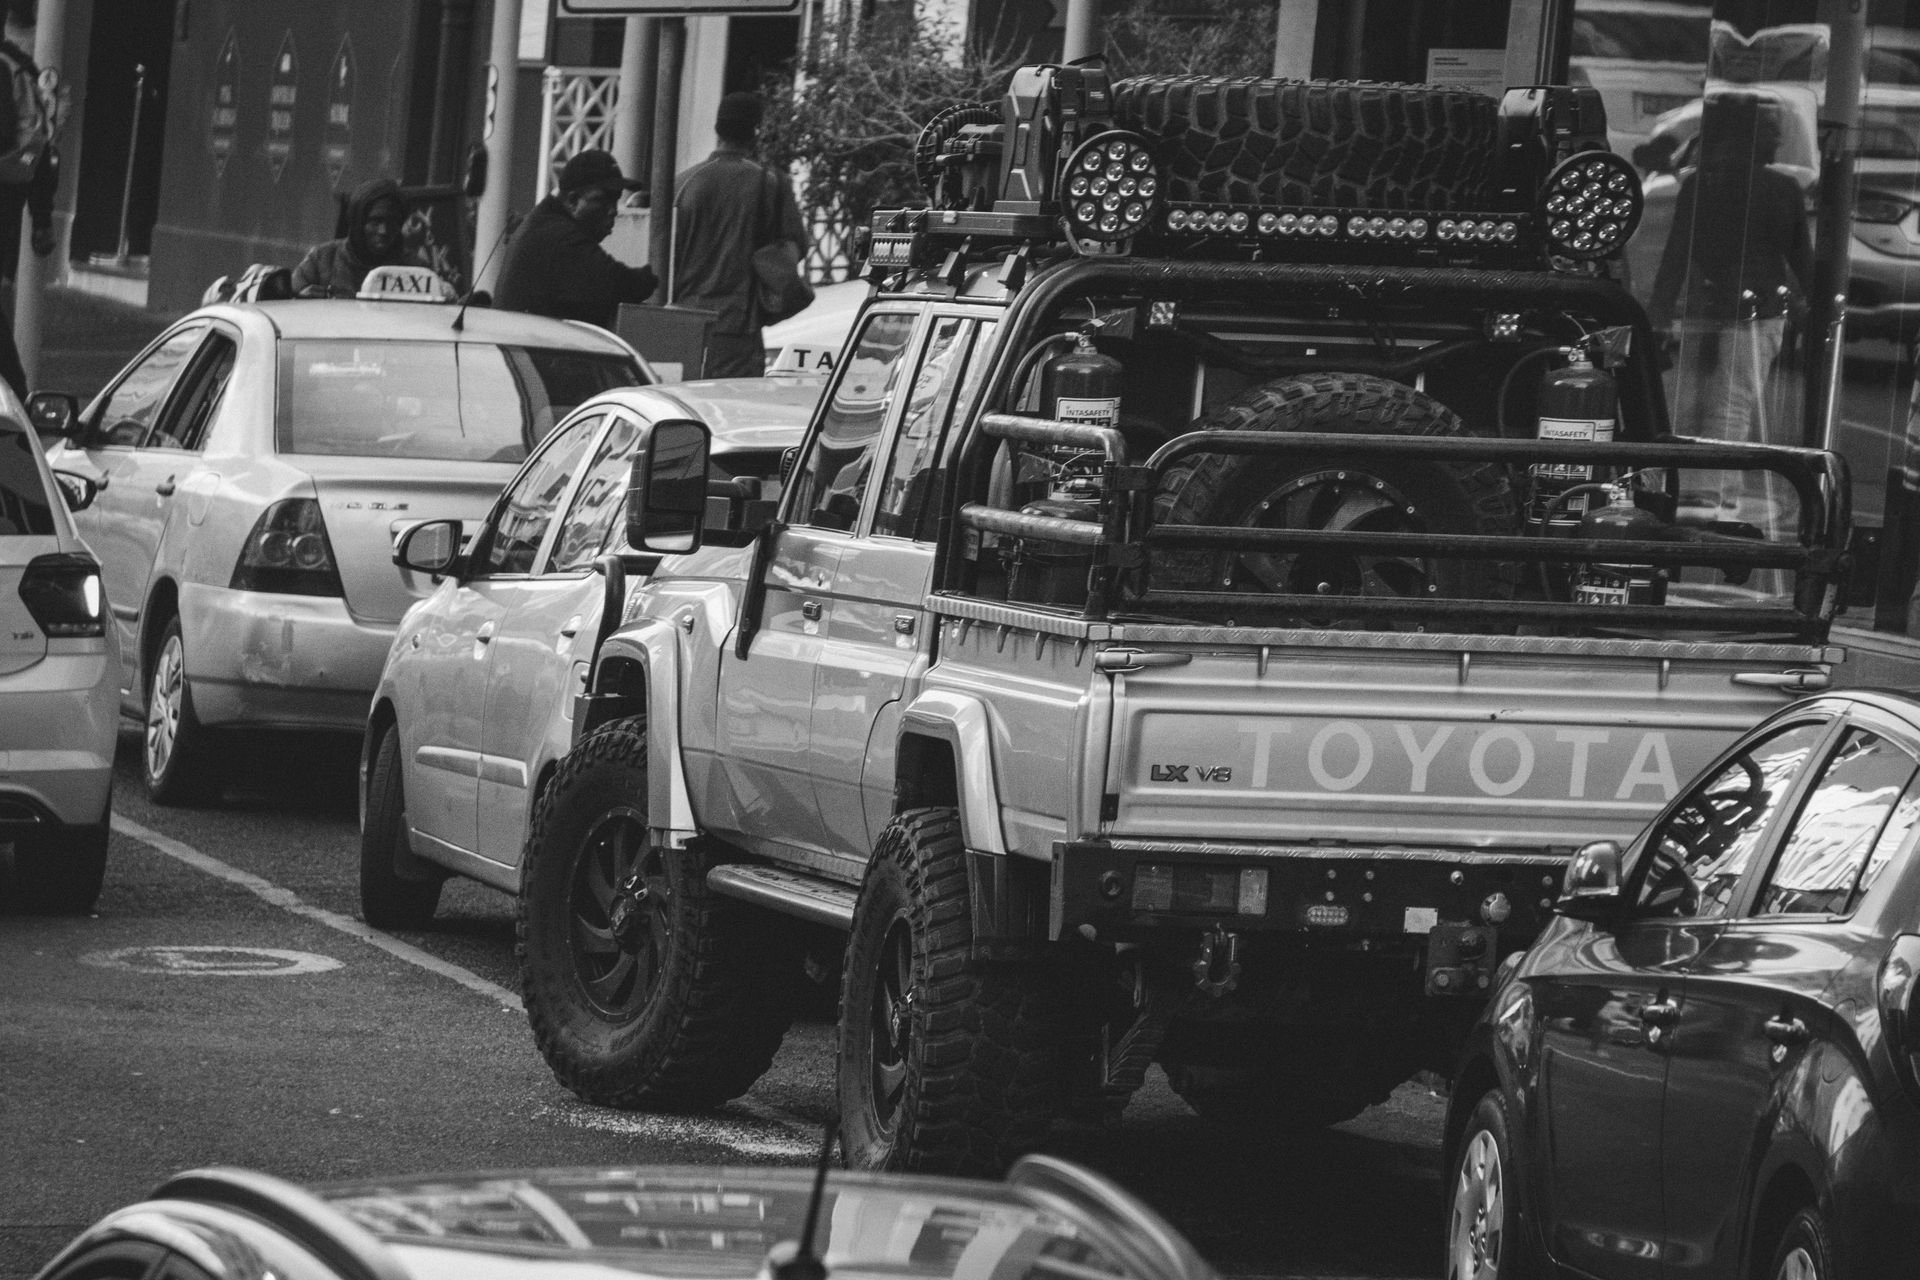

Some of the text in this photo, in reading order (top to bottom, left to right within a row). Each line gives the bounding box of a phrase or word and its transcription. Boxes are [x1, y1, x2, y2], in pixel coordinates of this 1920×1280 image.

[377, 272, 432, 294] TAXI
[793, 348, 834, 370] TA
[1238, 720, 1681, 801] TOYOTA
[1150, 764, 1233, 783] LX V8
